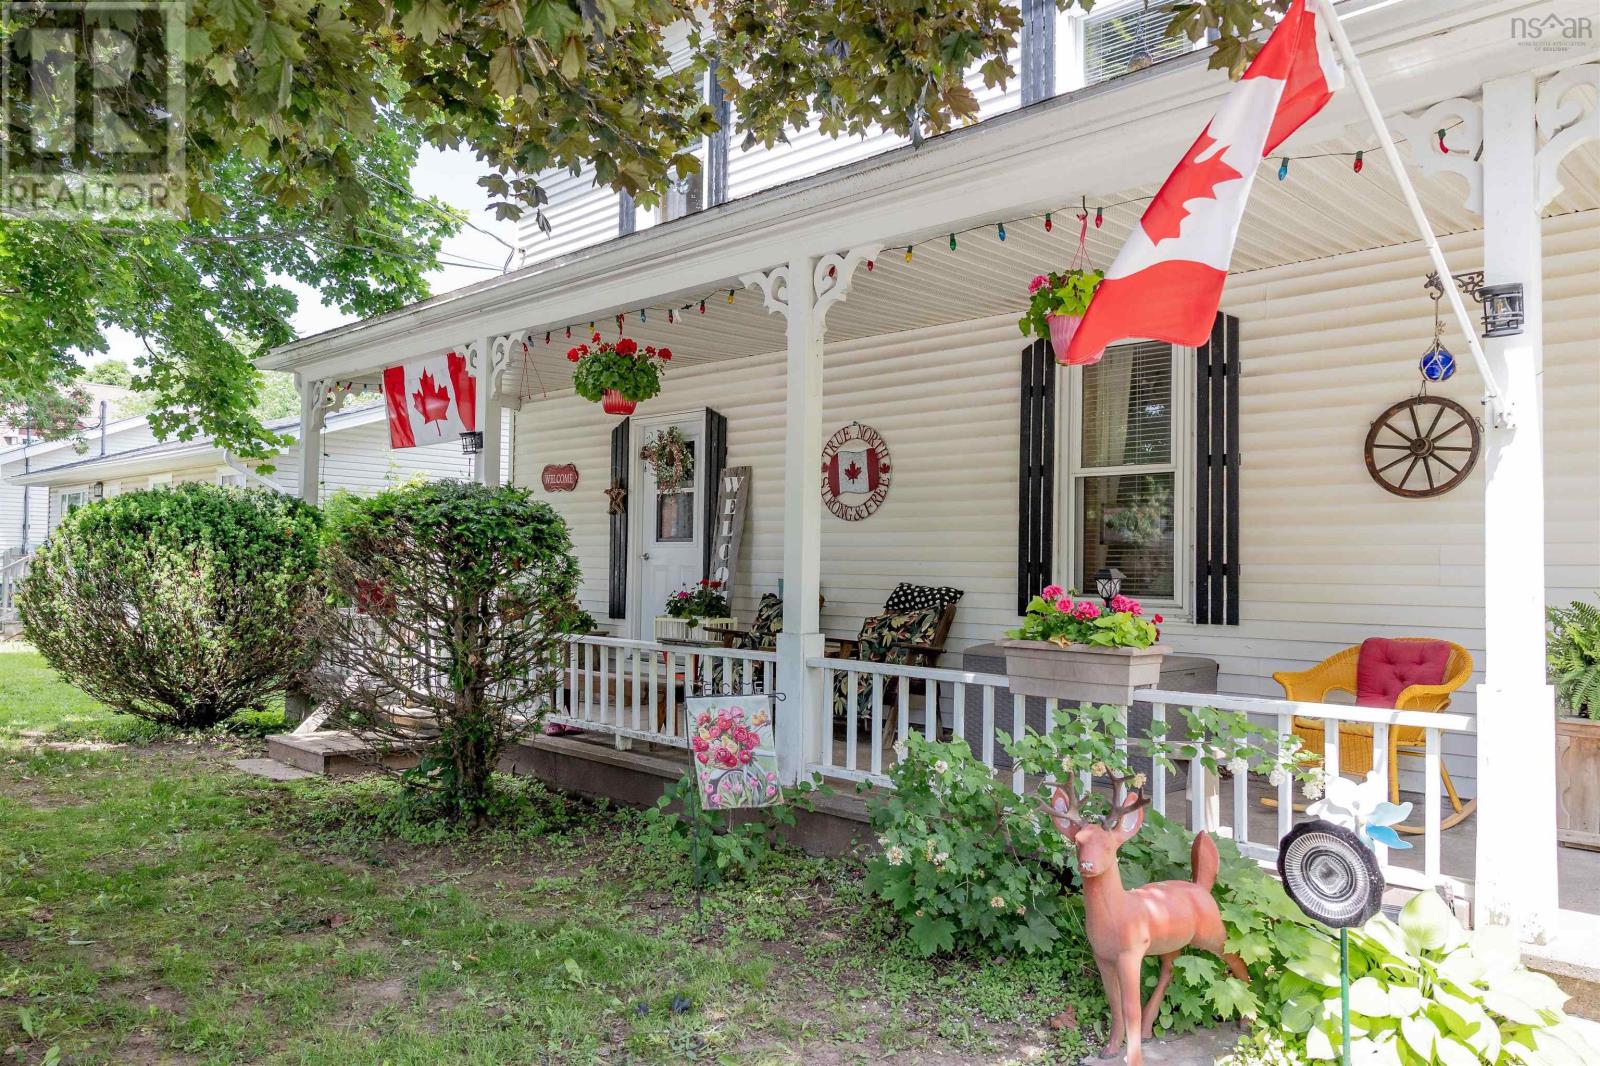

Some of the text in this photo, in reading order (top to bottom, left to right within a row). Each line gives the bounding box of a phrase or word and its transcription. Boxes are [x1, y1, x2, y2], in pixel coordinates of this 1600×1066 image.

[822, 424, 889, 460] TRUE NORTH
[544, 473, 574, 484] WELCOME
[821, 476, 890, 521] STRONG & FREE
[713, 476, 745, 605] WELCO
